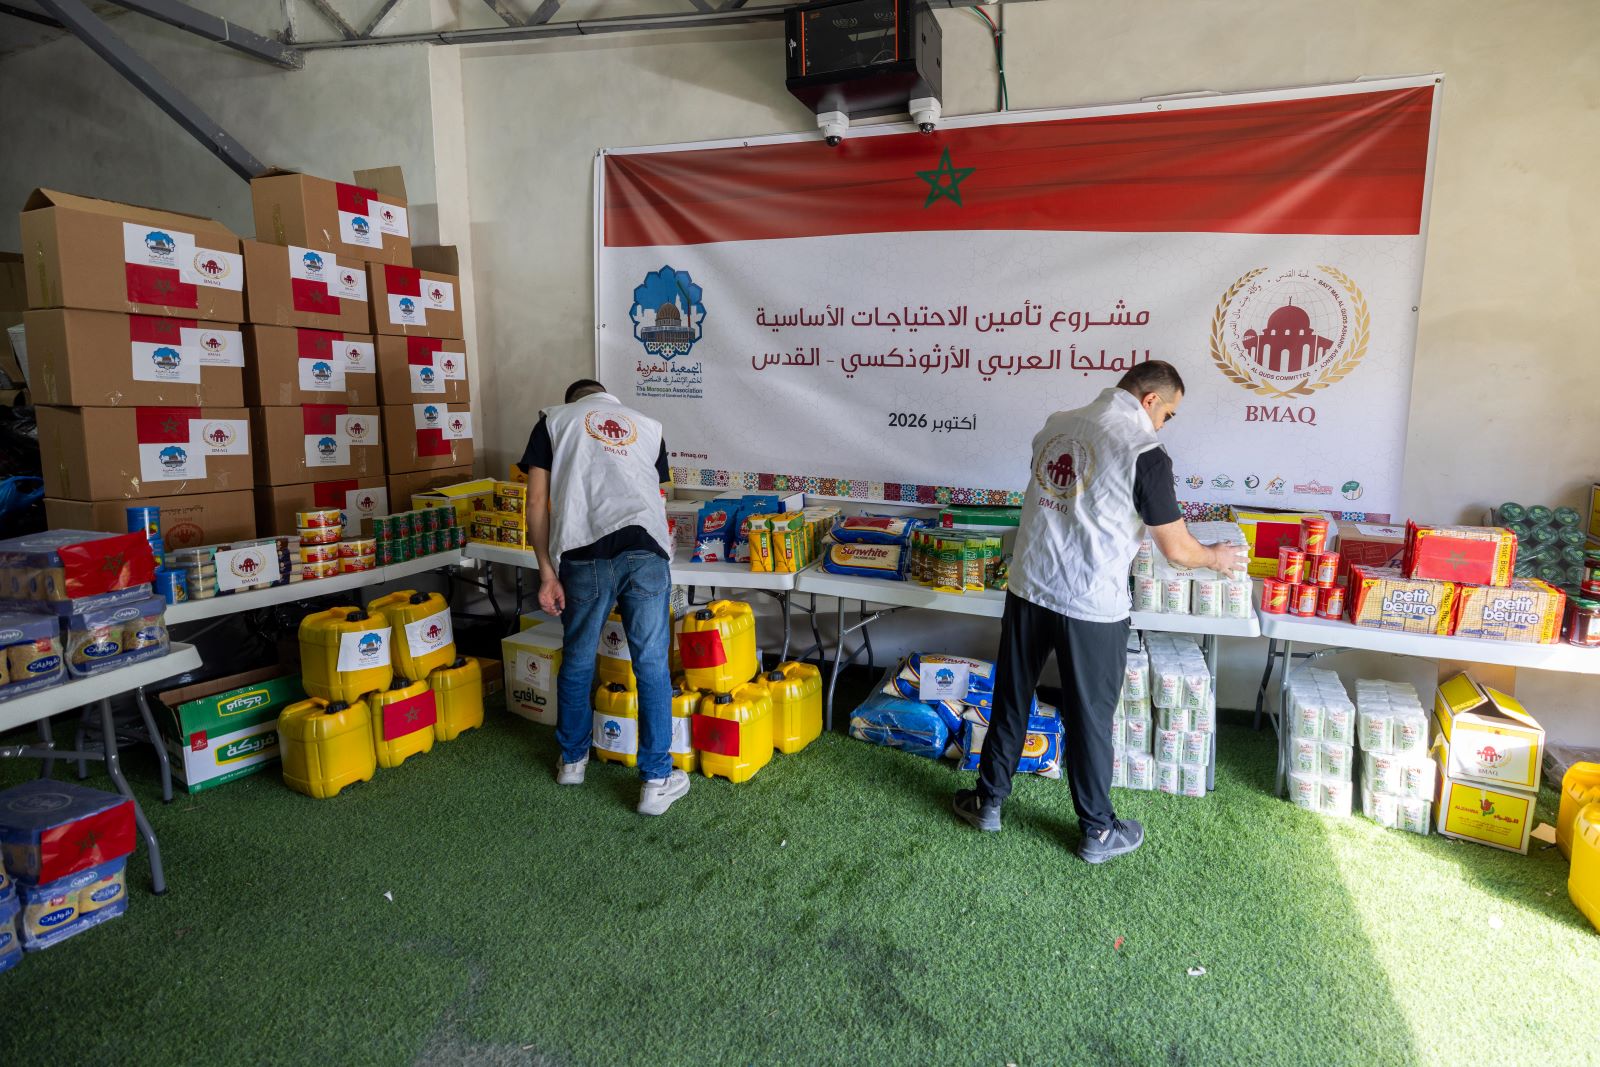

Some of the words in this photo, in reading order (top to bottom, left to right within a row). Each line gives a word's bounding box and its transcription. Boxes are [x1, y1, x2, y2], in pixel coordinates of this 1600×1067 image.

[1330, 289, 1340, 301] MAL
[756, 304, 845, 333] الأساسية
[851, 305, 968, 333] الاحتياجات
[975, 299, 1042, 333] تأمين
[752, 347, 820, 371] القدس
[840, 343, 970, 379] الأرثوذكسي
[978, 349, 1061, 382] العربي
[1320, 348, 1338, 369] AGENCY
[636, 361, 668, 377] المغربية
[670, 361, 702, 376] الجمعية
[1258, 371, 1275, 380] QUDS
[1275, 371, 1311, 381] COMMITTEE
[646, 385, 672, 393] Moroccan
[888, 412, 928, 428] 2026
[931, 413, 977, 433] أكتوبر
[1244, 405, 1318, 426] BMAQ
[603, 446, 629, 457] BMAQ
[1039, 497, 1069, 515] BMAQ
[841, 545, 889, 558] Sunwhite
[1502, 536, 1511, 559] Classic
[1498, 560, 1508, 582] Biscuit
[1392, 588, 1430, 603] petit
[1443, 587, 1453, 609] Classic
[1493, 597, 1533, 611] petit
[1382, 597, 1436, 615] beurre
[1483, 605, 1539, 624] beurre
[1547, 595, 1557, 619] Classic
[513, 687, 547, 706] صافي
[227, 734, 275, 757] فريكة
[41, 908, 73, 925] بقوليات
